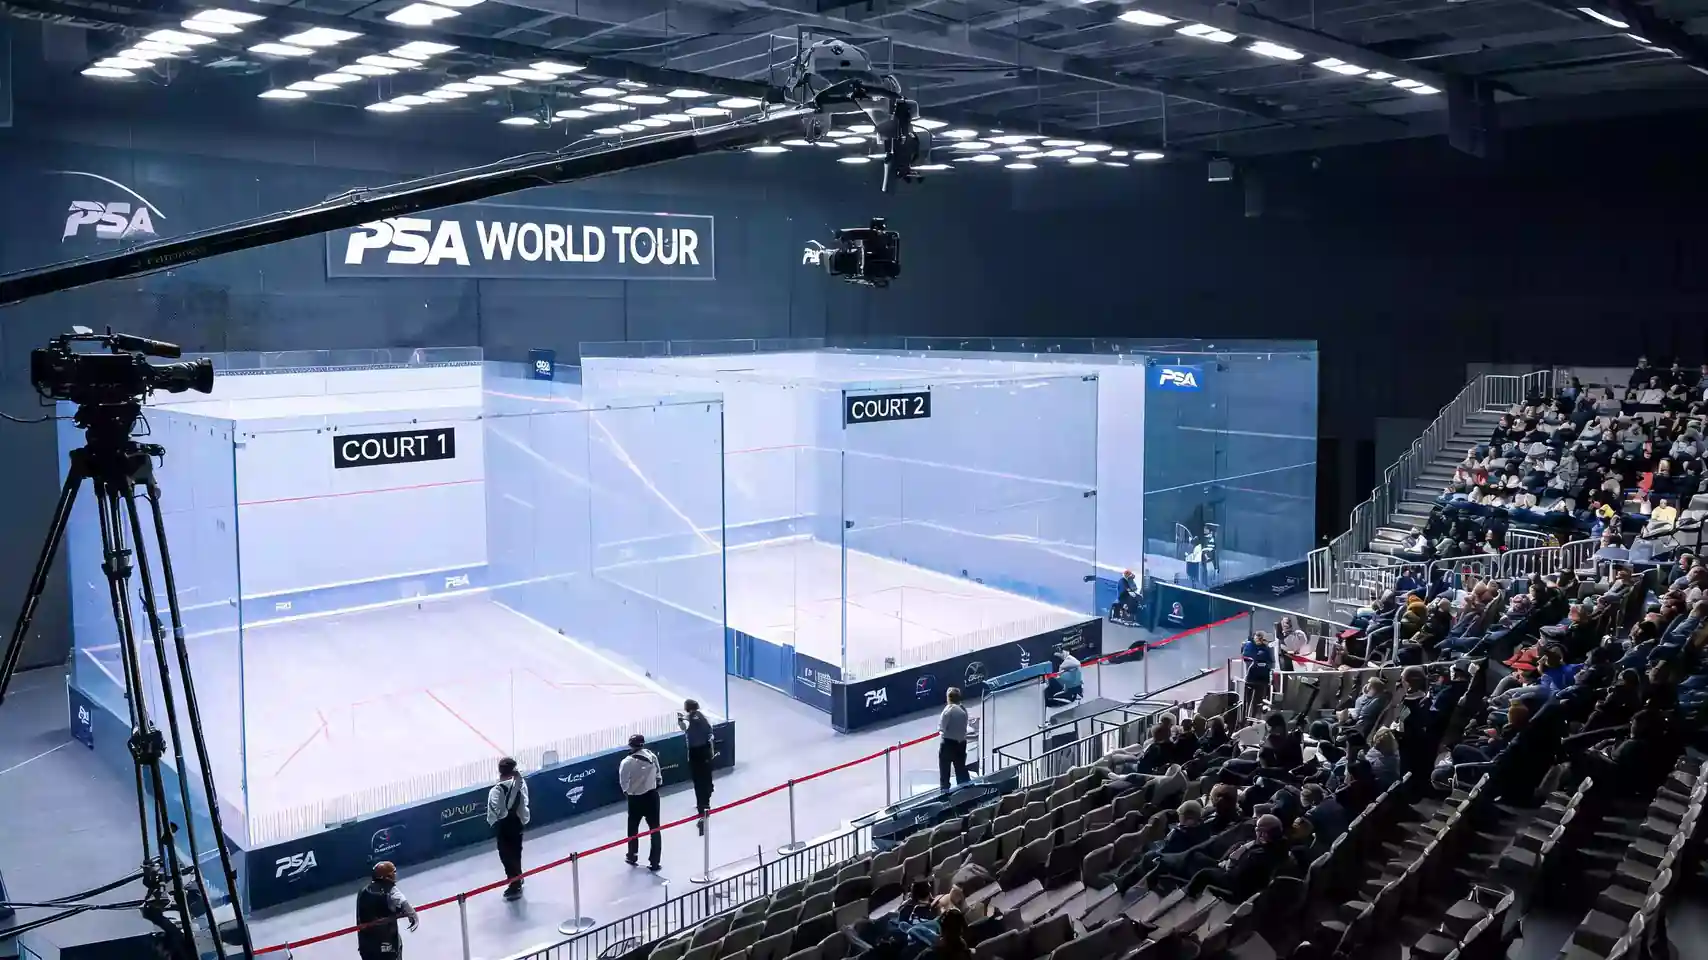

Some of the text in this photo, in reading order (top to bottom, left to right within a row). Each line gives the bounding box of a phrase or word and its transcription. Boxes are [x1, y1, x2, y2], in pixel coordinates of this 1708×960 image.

[61, 200, 156, 243] PSA
[345, 217, 700, 266] PSA WORLD TOUR
[1160, 368, 1198, 388] PSA
[852, 396, 925, 419] COURT 2
[342, 433, 446, 461] COURT 1
[864, 686, 888, 708] PSA
[275, 850, 318, 878] PSA
